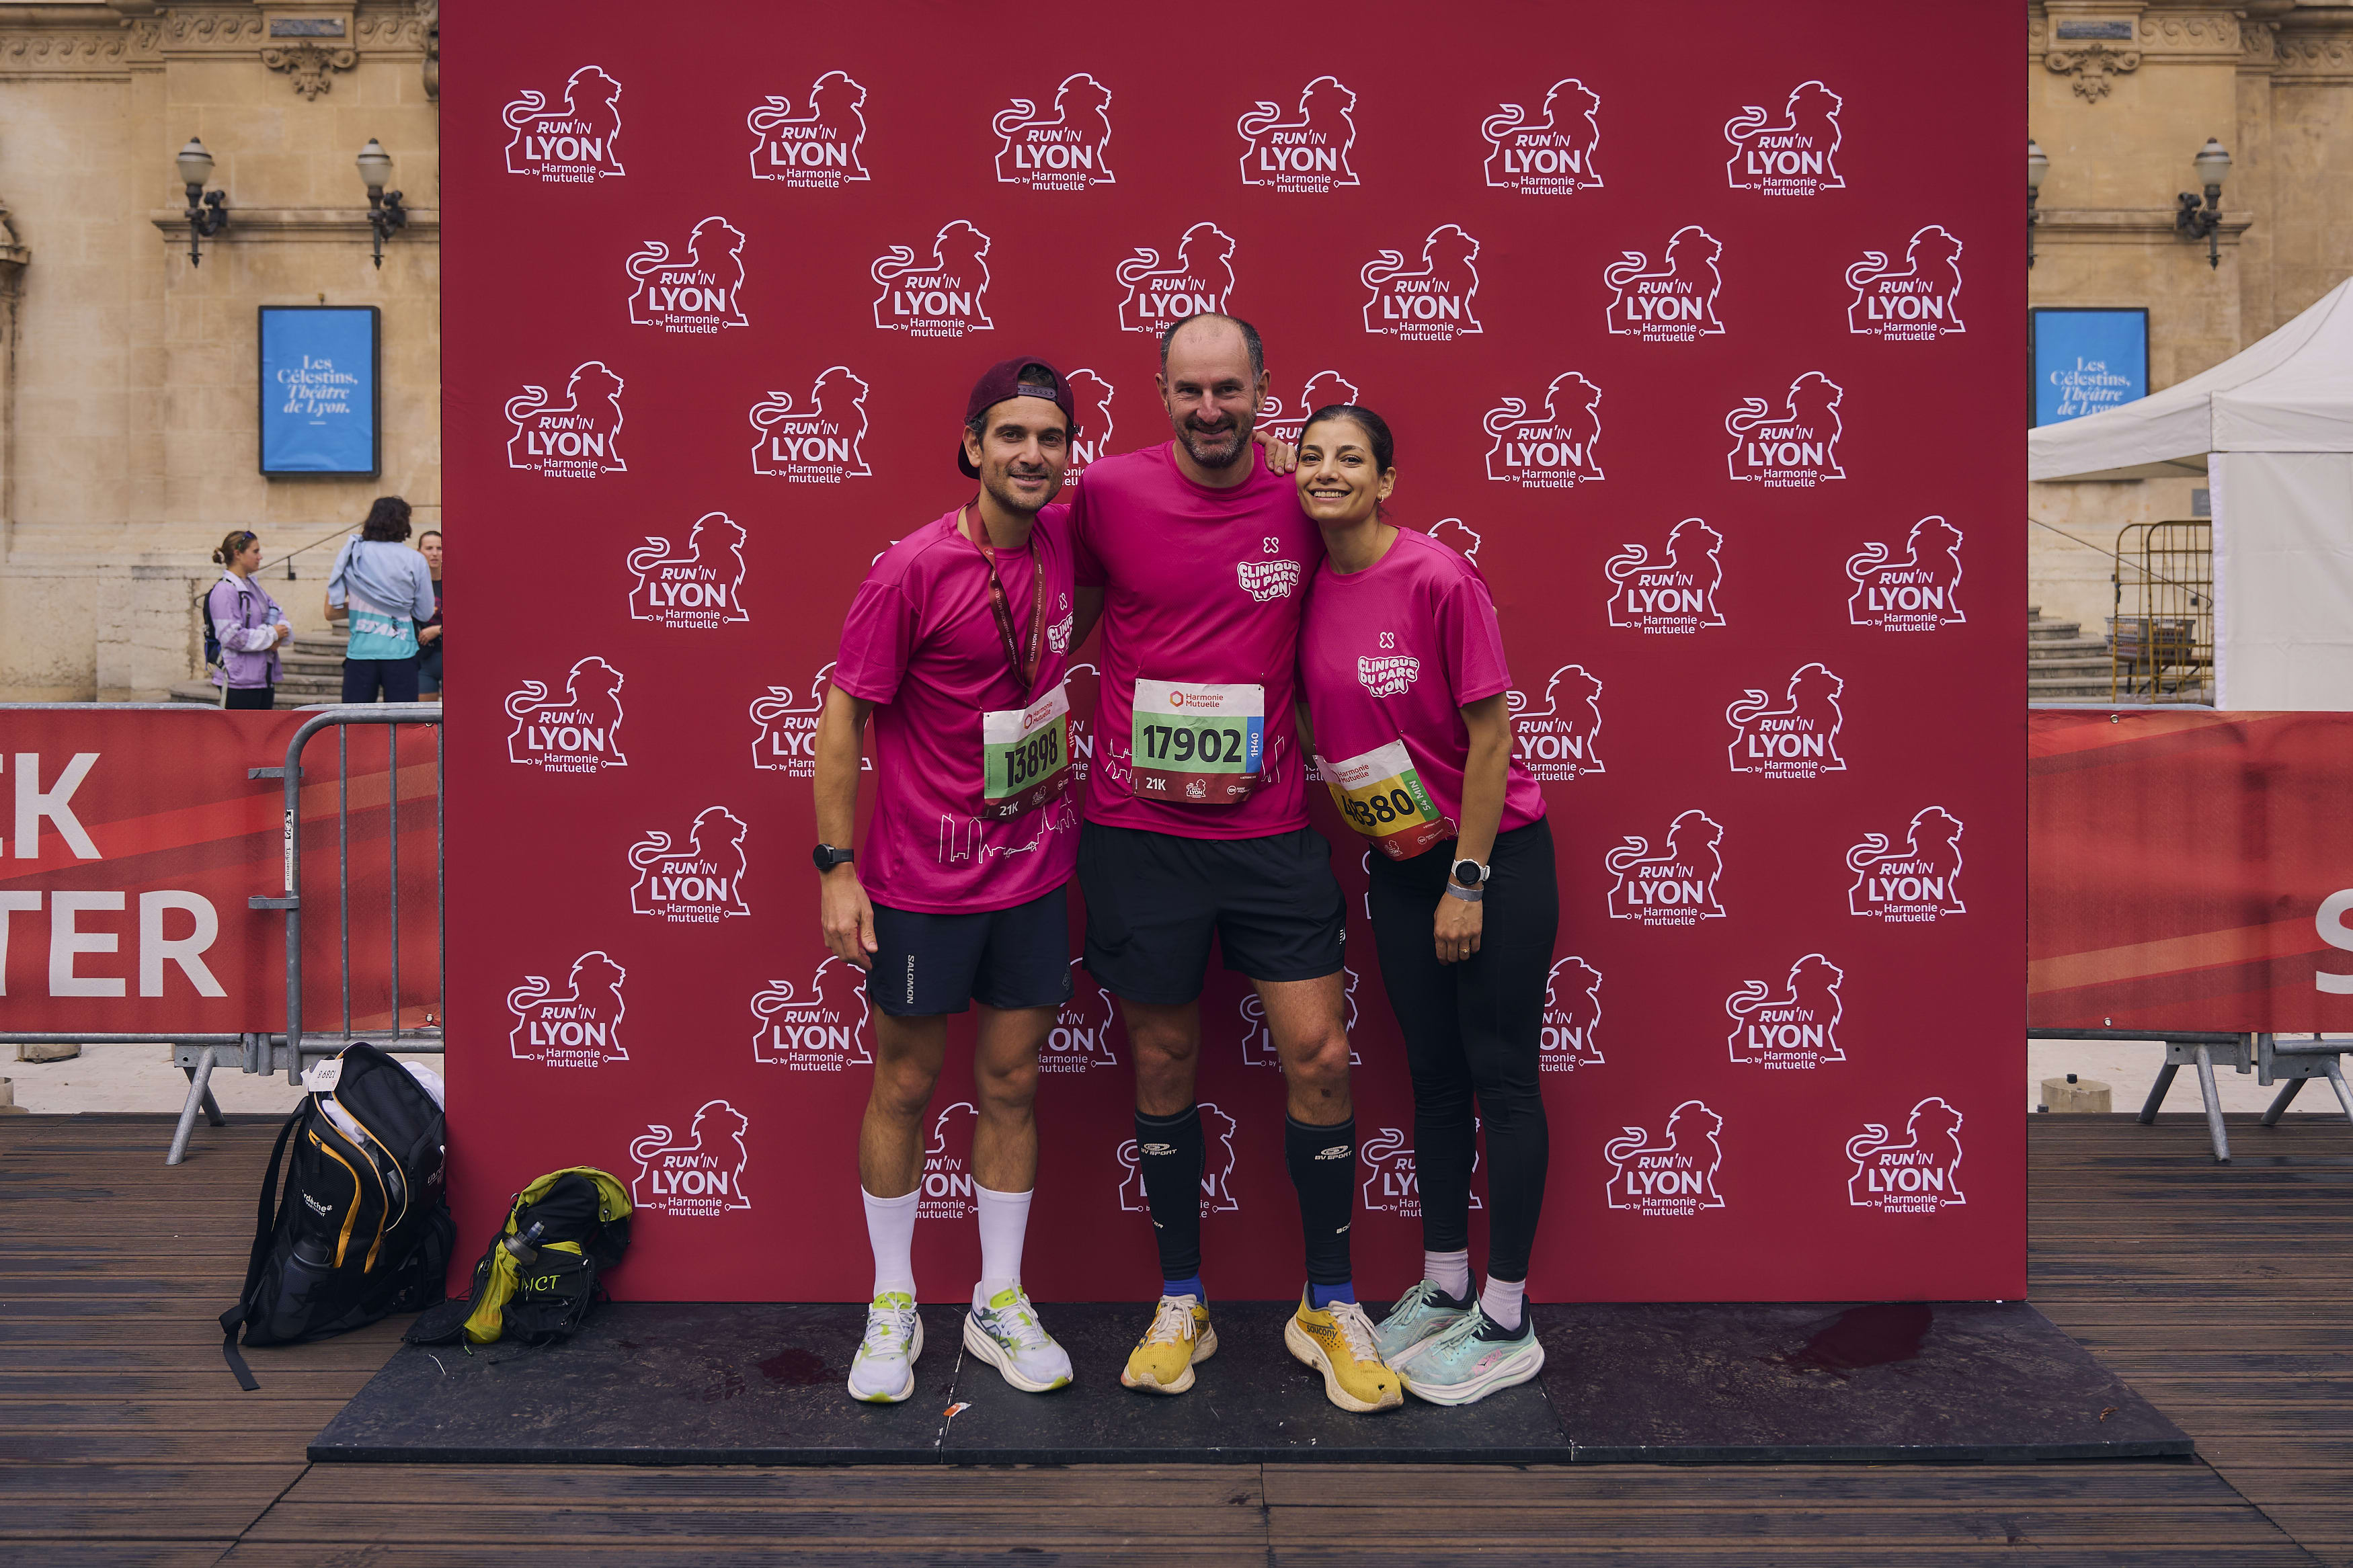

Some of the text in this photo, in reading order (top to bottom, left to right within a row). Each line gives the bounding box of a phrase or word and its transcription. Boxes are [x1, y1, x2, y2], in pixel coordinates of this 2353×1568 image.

[526, 136, 602, 161] LYON
[1016, 144, 1092, 169] LYON
[1747, 151, 1823, 175] LYON
[532, 163, 596, 176] by Harmonie
[1032, 171, 1086, 181] Harmonie
[542, 173, 594, 183] mutuelle
[1753, 177, 1817, 190] by Harmonie
[1033, 181, 1084, 191] mutuelle
[1763, 186, 1815, 196] mutuelle
[649, 286, 725, 312] LYON
[1140, 293, 1215, 318] LYON
[1384, 295, 1460, 319] LYON
[1868, 295, 1943, 320] LYON
[655, 313, 720, 327] by Harmonie
[1399, 321, 1454, 331] Harmonie
[666, 323, 718, 334] mutuelle
[1146, 325, 1154, 333] by
[1874, 321, 1938, 335] by Harmonie
[1400, 331, 1452, 341] mutuelle
[1884, 331, 1936, 341] mutuelle
[303, 355, 332, 370] Les
[2077, 356, 2106, 372] Les
[277, 368, 358, 385] Célestins,
[2050, 370, 2131, 387] Célestins,
[288, 384, 350, 400] Théâtre
[2061, 386, 2122, 401] Théâtre
[283, 399, 350, 417] de Lyon.
[2057, 401, 2077, 415] de
[772, 436, 848, 462] LYON
[779, 464, 843, 477] by Harmonie
[789, 473, 841, 484] mutuelle
[1239, 563, 1299, 577] CLINIQUE
[1242, 571, 1296, 589] DU PARC
[1254, 581, 1287, 599] LYON
[994, 587, 1004, 610] MUTUELLE
[1628, 589, 1703, 613] LYON
[1643, 615, 1698, 625] Harmonie
[1644, 624, 1696, 634] mutuelle
[1052, 638, 1065, 650] DU
[1359, 659, 1418, 673] CLINIQUE
[1360, 667, 1414, 684] DU PARC
[1371, 677, 1404, 694] LYON
[1186, 693, 1224, 701] Harmonie
[1033, 701, 1053, 716] Harmonie
[1033, 708, 1051, 724] Mutuelle
[528, 725, 604, 751] LYON
[1143, 725, 1242, 763] 17902
[1250, 733, 1259, 757] 1H40
[1512, 735, 1582, 759] LYON
[534, 753, 599, 766] by Harmonie
[1005, 727, 1058, 788] 13898
[545, 763, 597, 773] mutuelle
[1338, 764, 1369, 778] Harmonie
[1146, 777, 1166, 791] 21K
[1341, 772, 1369, 783] Mutuelle
[1409, 780, 1431, 811] 54 MIN
[0, 753, 102, 859] K
[1000, 801, 1019, 816] 21K
[651, 876, 727, 901] LYON
[1868, 876, 1943, 901] LYON
[667, 903, 721, 913] Harmonie
[1884, 903, 1938, 913] Harmonie
[668, 913, 719, 923] mutuelle
[1884, 912, 1936, 923] mutuelle
[774, 1025, 849, 1050] LYON
[1749, 1024, 1823, 1048] LYON
[780, 1052, 844, 1065] by Harmonie
[1763, 1050, 1818, 1061] Harmonie
[790, 1061, 842, 1071] mutuelle
[1764, 1060, 1816, 1070] mutuelle
[1327, 1150, 1352, 1160] SPORT
[653, 1169, 727, 1195] LYON
[1868, 1167, 1943, 1192] LYON
[659, 1196, 722, 1210] by Harmonie
[1884, 1194, 1938, 1204] Harmonie
[668, 1206, 720, 1216] mutuelle
[1884, 1203, 1936, 1213] mutuelle
[1306, 1324, 1338, 1339] saucony
